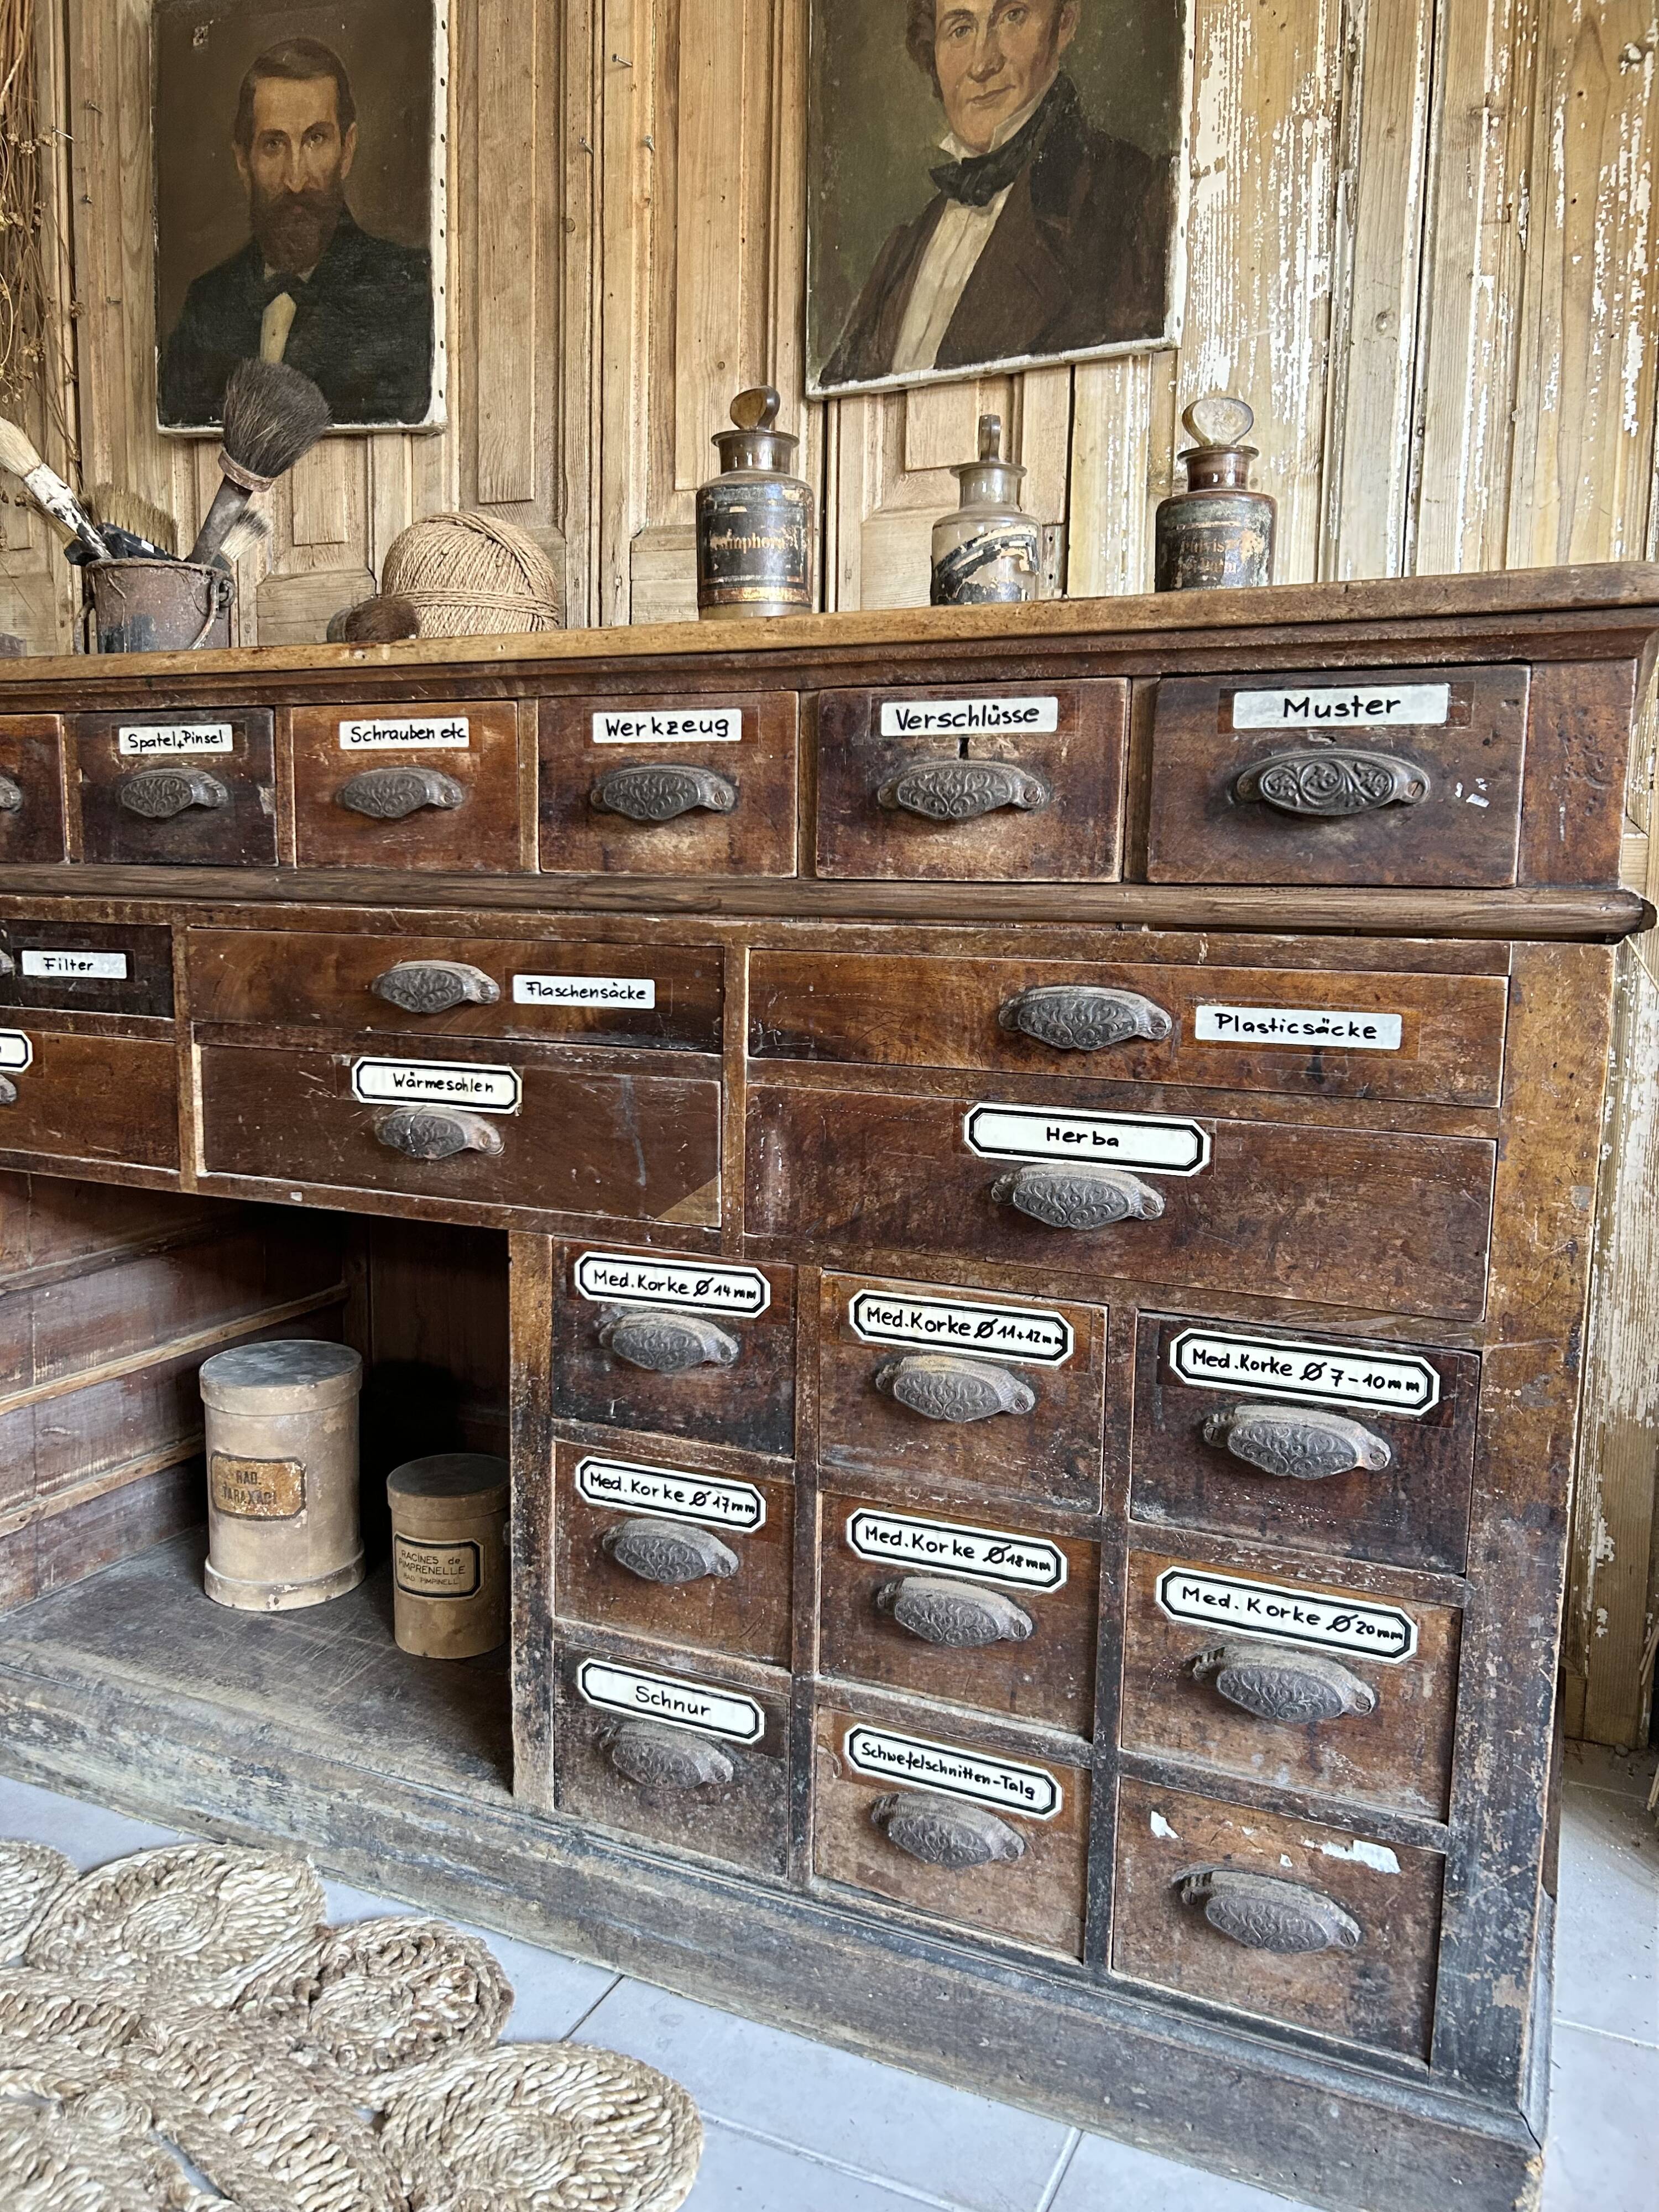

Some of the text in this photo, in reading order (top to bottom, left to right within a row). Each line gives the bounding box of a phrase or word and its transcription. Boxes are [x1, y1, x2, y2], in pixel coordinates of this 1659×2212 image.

[1283, 695, 1401, 718] Muster
[606, 717, 729, 738] Werkzeug
[895, 704, 1040, 731] Verschlüsse
[351, 722, 466, 743] Schrauben etc
[43, 957, 93, 971] Filter
[1214, 1013, 1378, 1040] Plasticsäcke
[393, 1071, 494, 1093] Wärmesohlen
[1046, 1126, 1119, 1147] Herba
[399, 1557, 466, 1575] PIMPRENELLE
[401, 1550, 439, 1564] RACINES
[635, 1686, 711, 1717] Schnur
